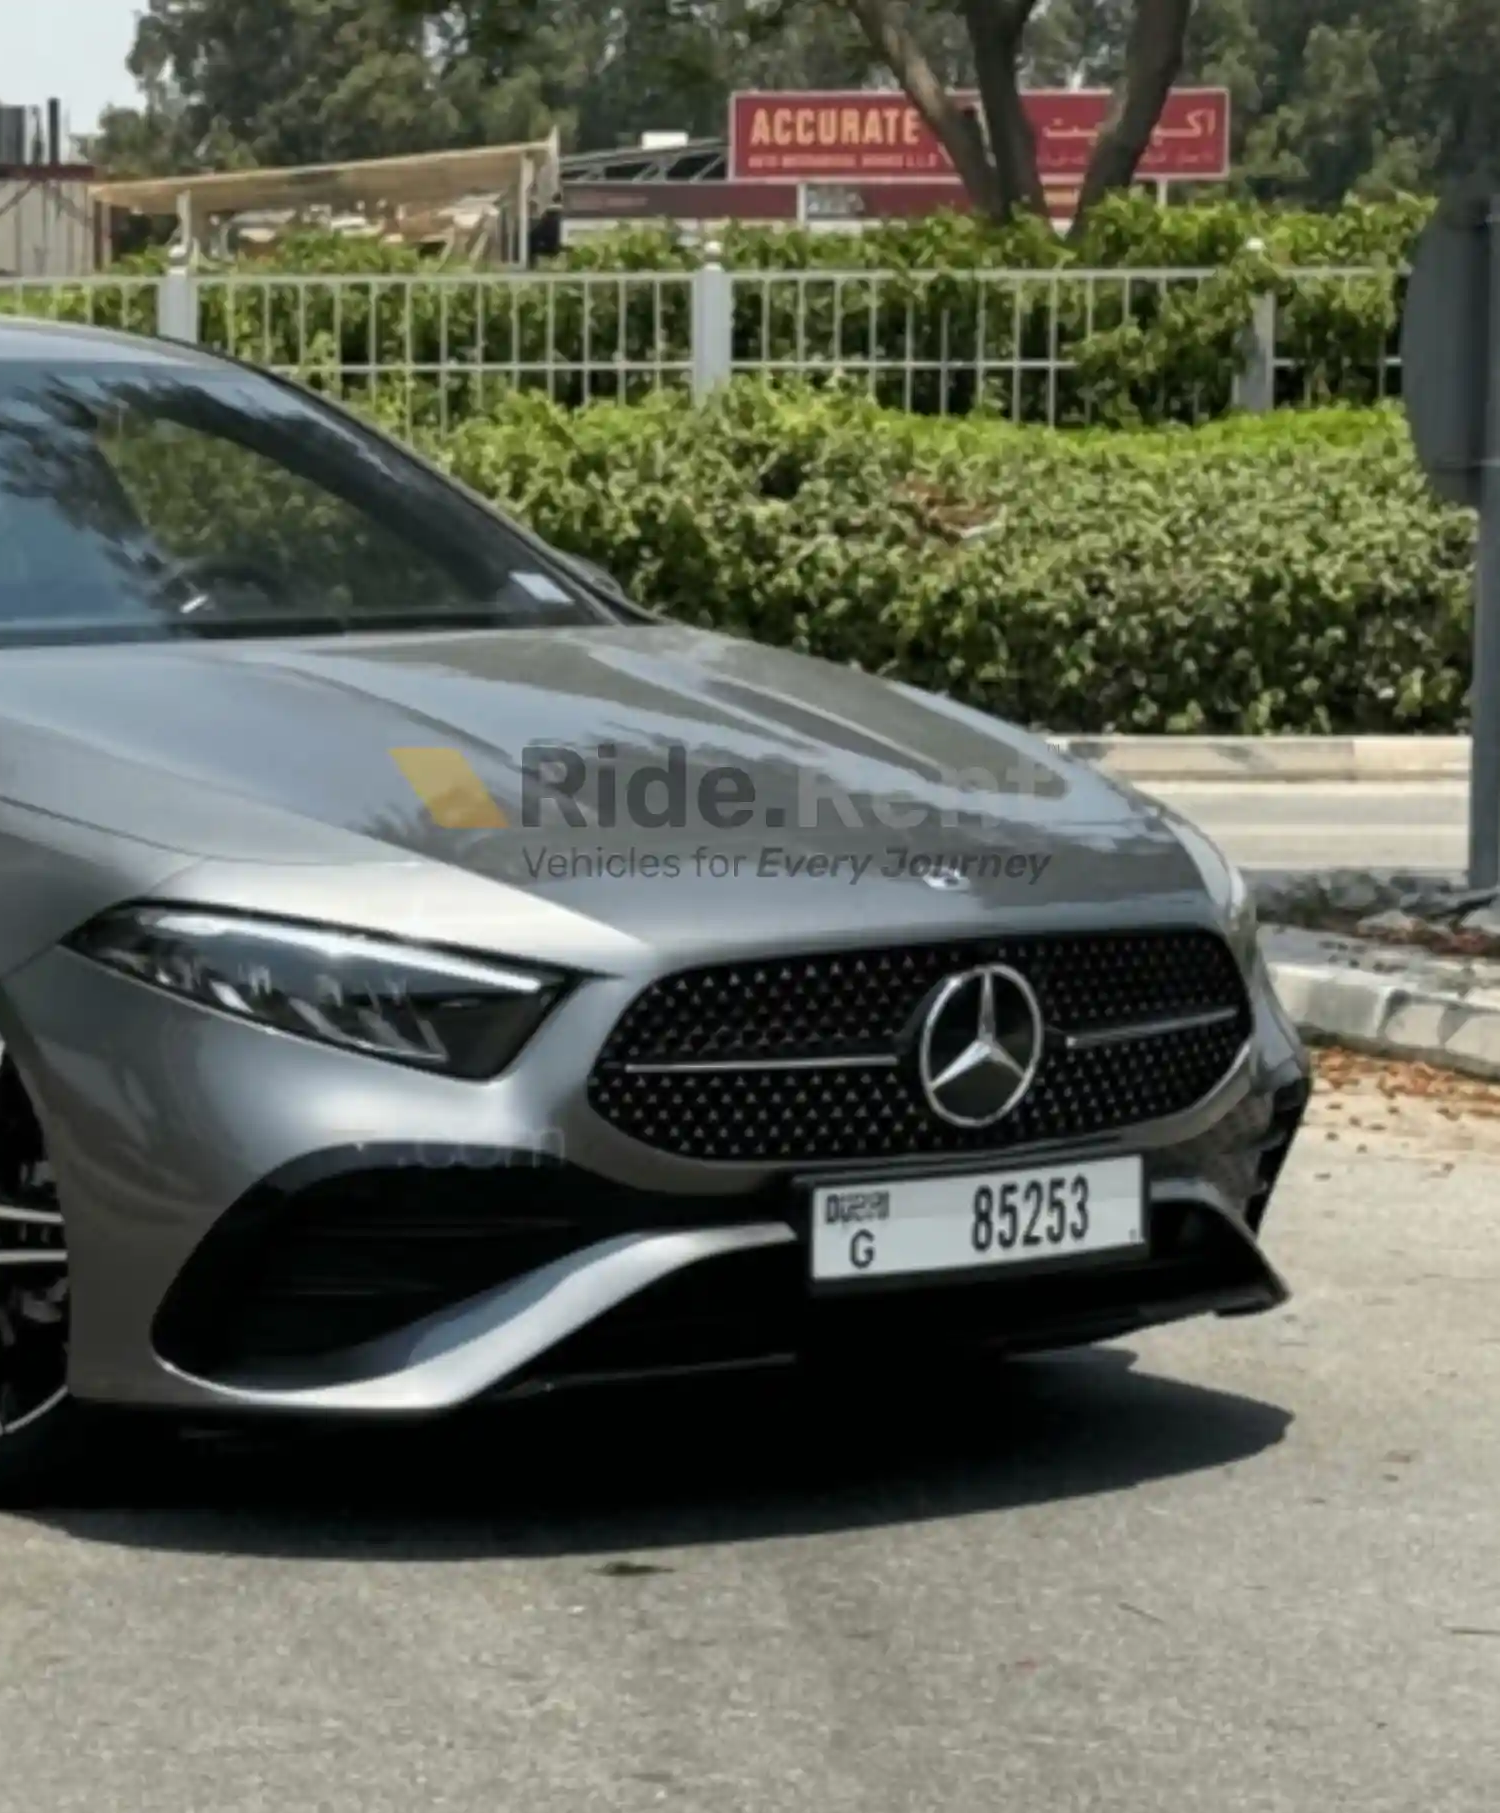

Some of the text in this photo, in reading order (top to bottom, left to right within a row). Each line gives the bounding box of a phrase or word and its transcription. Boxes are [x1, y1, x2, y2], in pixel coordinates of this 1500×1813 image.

[750, 107, 920, 146] ACCURATE
[848, 1172, 1090, 1271] G 85253
